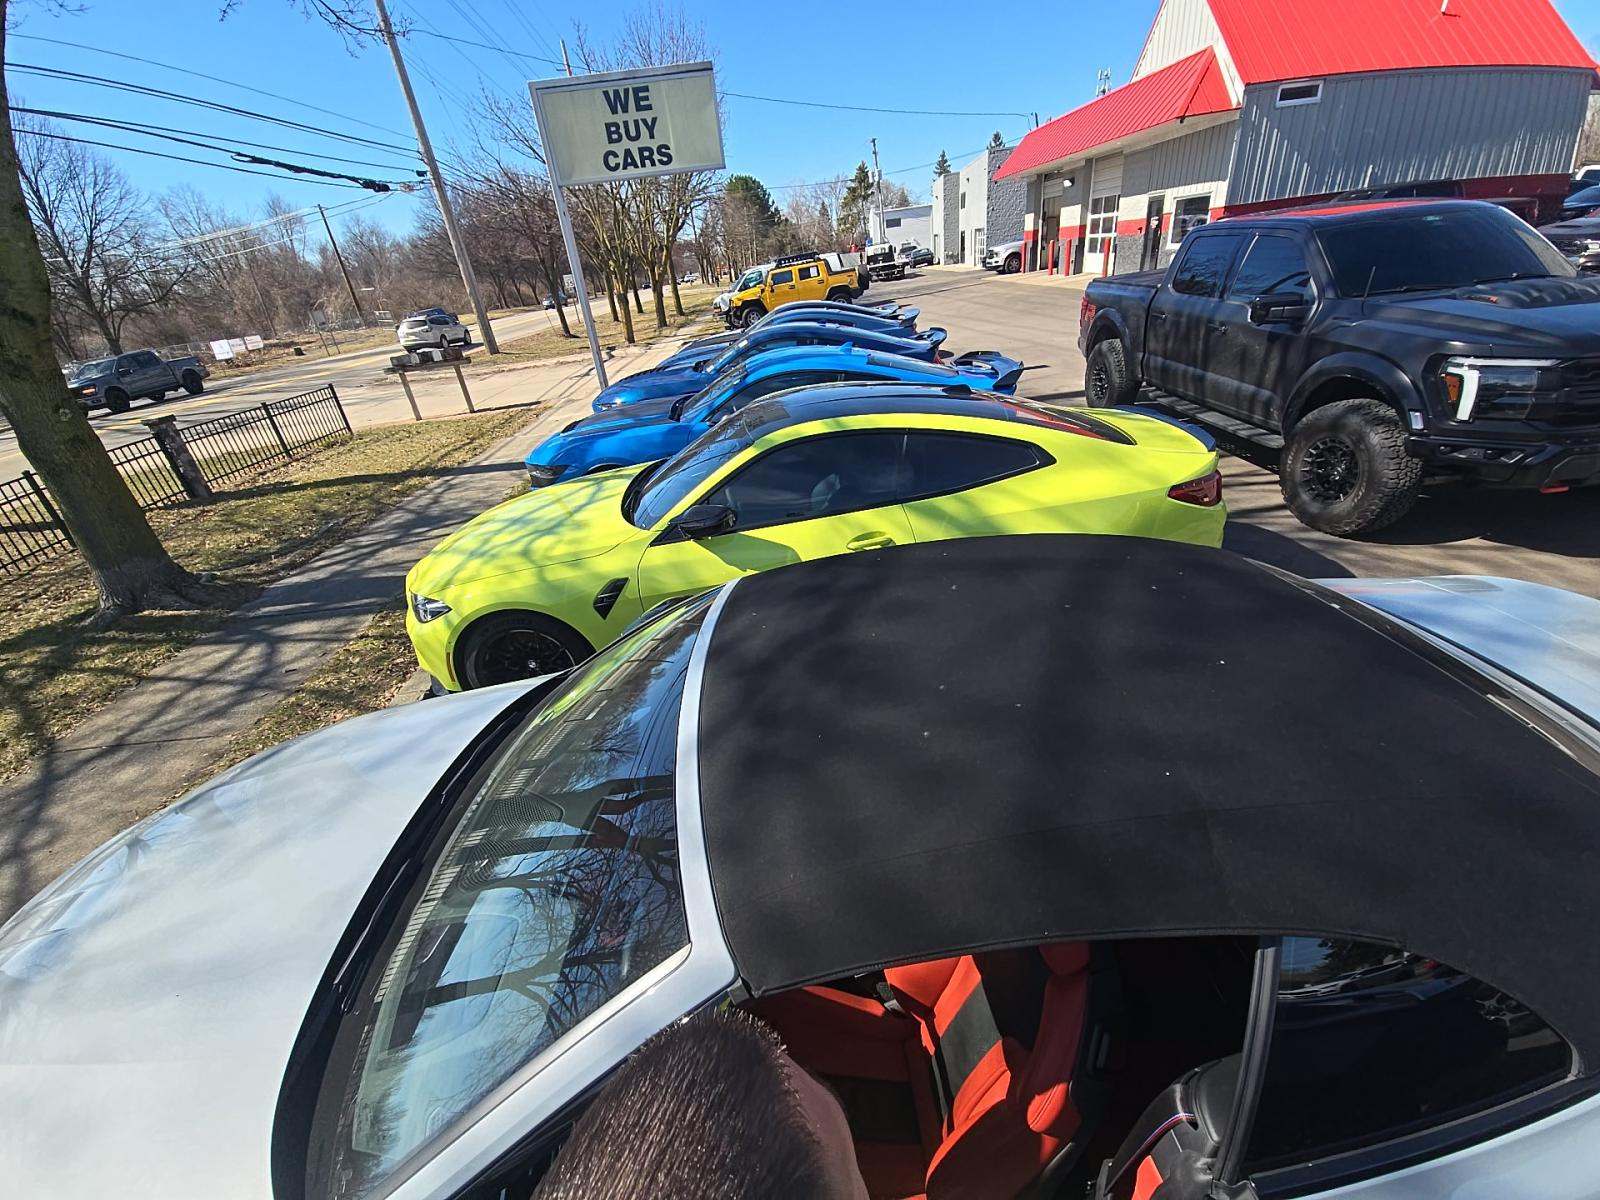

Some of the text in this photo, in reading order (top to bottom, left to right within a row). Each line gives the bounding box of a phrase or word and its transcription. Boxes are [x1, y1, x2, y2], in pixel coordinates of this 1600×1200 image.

[602, 85, 653, 115] WE
[604, 117, 658, 144] BUY
[603, 143, 673, 172] CARS
